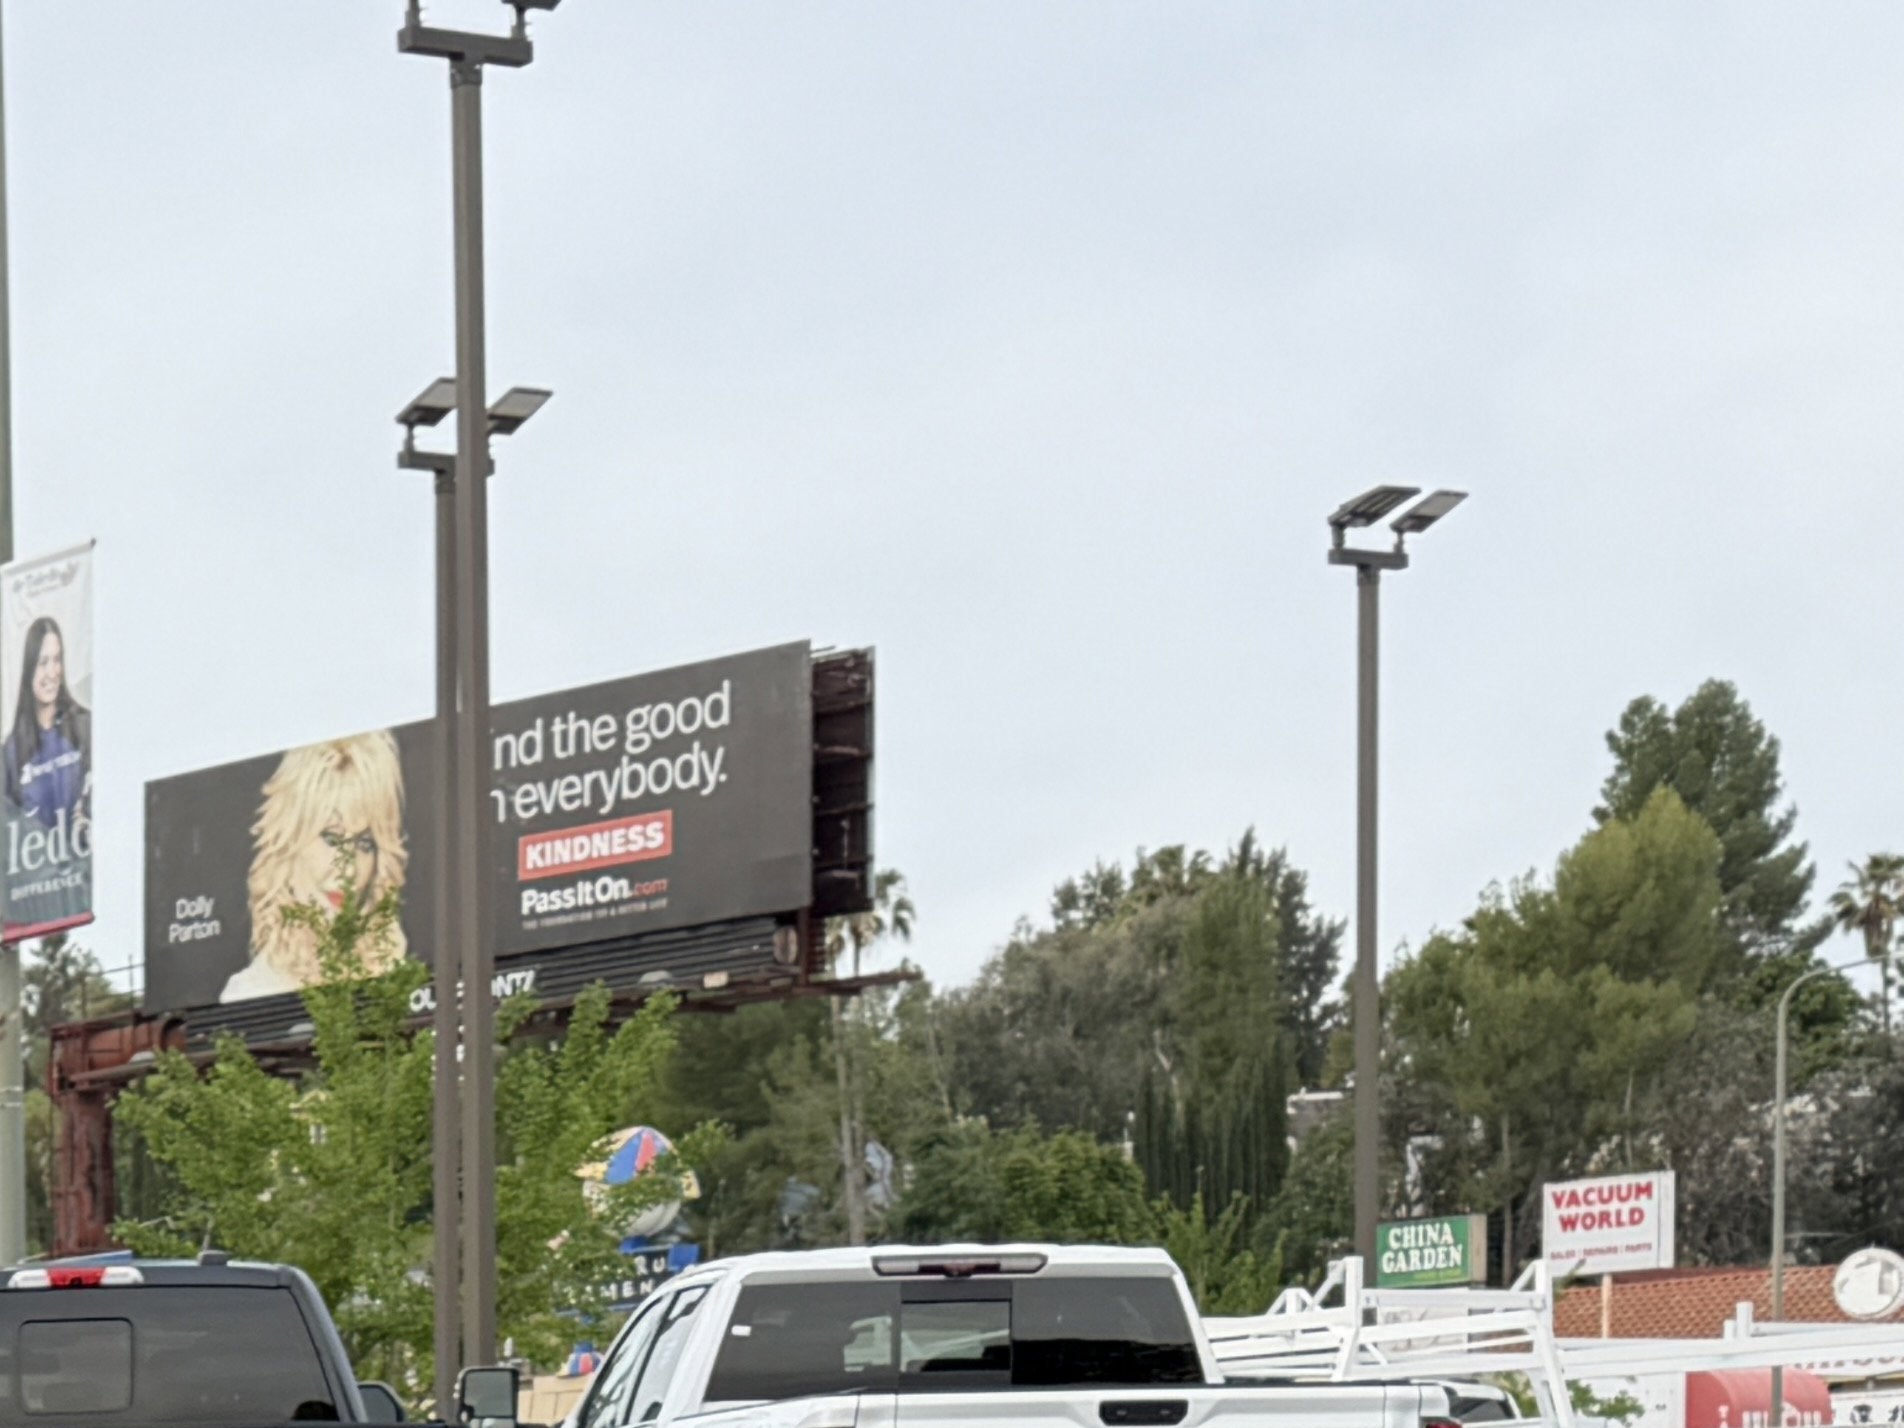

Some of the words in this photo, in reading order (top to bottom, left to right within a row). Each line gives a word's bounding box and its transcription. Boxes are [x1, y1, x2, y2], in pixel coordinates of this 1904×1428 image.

[494, 717, 542, 771] nd
[550, 711, 617, 760] the
[624, 679, 731, 755] good
[490, 790, 506, 823] n
[513, 741, 728, 819] everybody.
[525, 821, 666, 870] KINDNESS
[175, 895, 216, 921] Dolly
[168, 917, 221, 944] Parton
[1550, 1181, 1654, 1210] VACUUM
[1558, 1206, 1646, 1233] WORLD
[1388, 1221, 1455, 1250] CHINA
[1381, 1244, 1463, 1274] GARDEN
